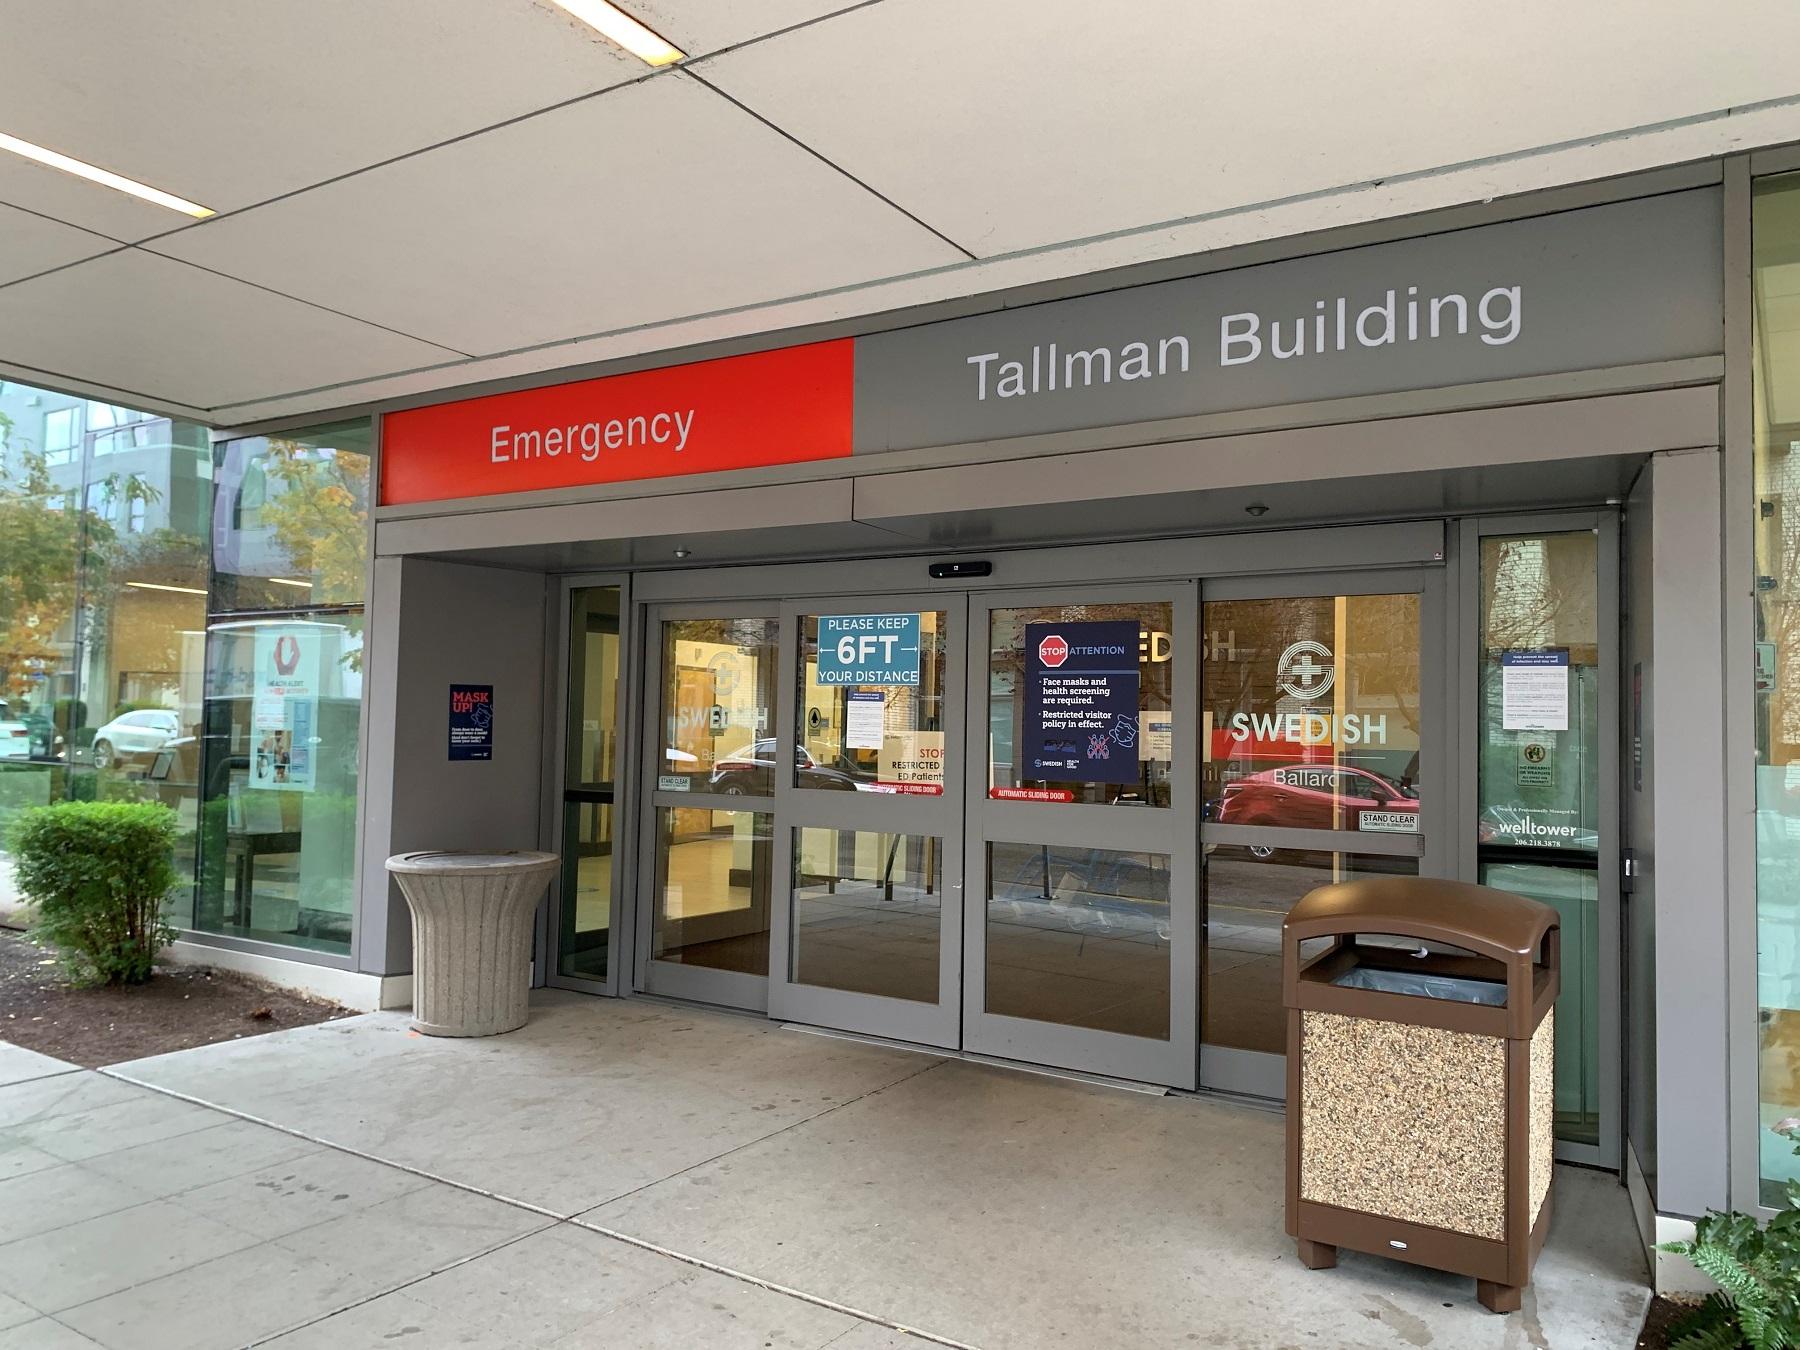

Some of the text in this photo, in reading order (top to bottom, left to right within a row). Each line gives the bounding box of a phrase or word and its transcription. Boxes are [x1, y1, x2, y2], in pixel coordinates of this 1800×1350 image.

[966, 285, 1522, 401] Tallman Building
[491, 409, 694, 463] Emergency
[828, 617, 909, 631] PLEASE KEEP
[837, 635, 899, 665] 6FT
[1041, 646, 1125, 656] STOP ATTENTION
[819, 670, 918, 683] YOUR DISTANCE
[1042, 677, 1107, 686] Face masks and
[453, 691, 489, 703] MASK
[1042, 687, 1110, 697] health screening
[1057, 696, 1095, 706] required.
[453, 702, 473, 713] UP!
[679, 706, 768, 730] SWEDH
[1042, 710, 1112, 719] Restricted visitor
[1042, 720, 1105, 729] policy in effect.
[1231, 712, 1387, 744] SWEDISH
[892, 761, 940, 770] RESTRICTED
[898, 773, 909, 781] ED
[904, 784, 922, 792] SLIDING
[923, 785, 937, 793] DOOR
[998, 789, 1065, 800] AUTOMATIC SLIDING DOOR
[1363, 814, 1415, 823] STAND CLEAR
[1499, 815, 1577, 837] welltower
[1514, 838, 1561, 848] 206.218.3878
